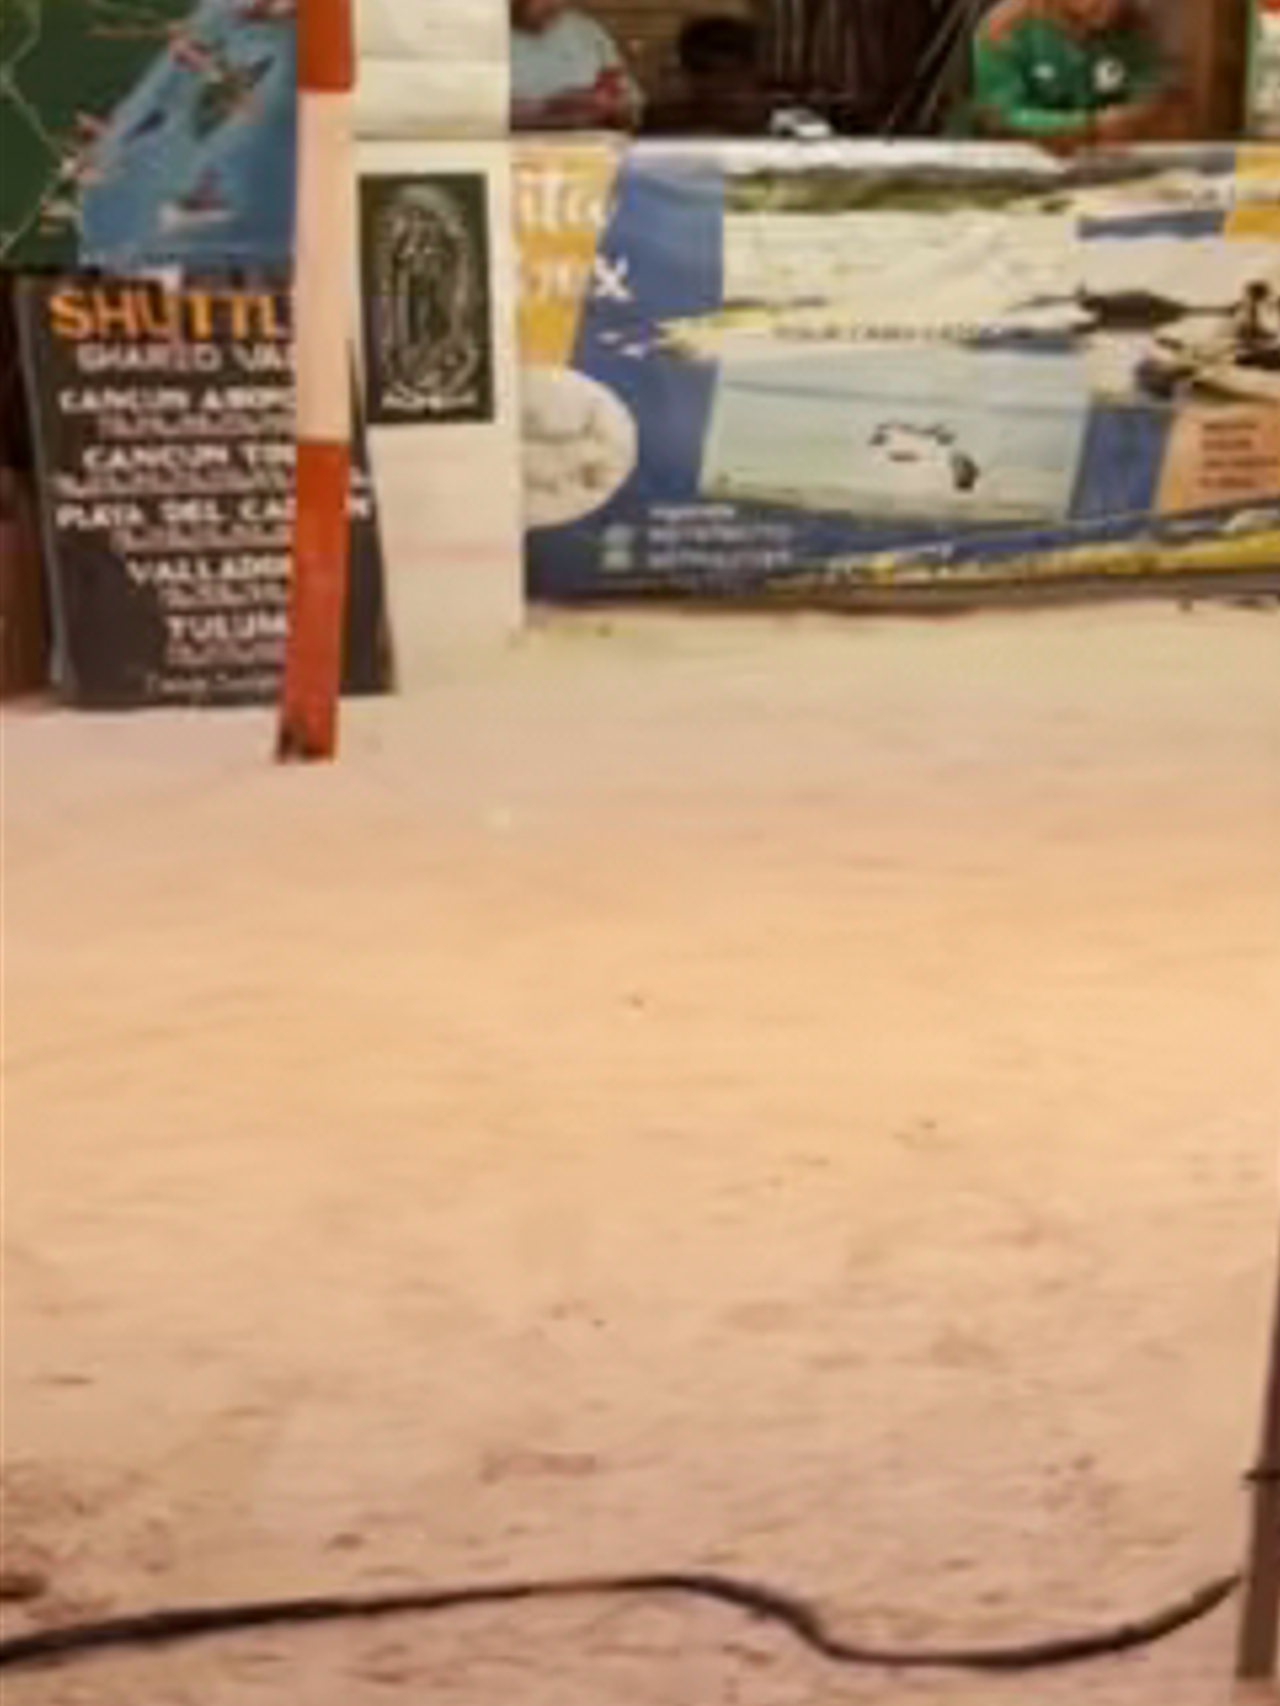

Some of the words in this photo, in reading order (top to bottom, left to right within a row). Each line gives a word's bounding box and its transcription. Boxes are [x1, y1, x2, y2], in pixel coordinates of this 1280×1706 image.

[48, 288, 296, 340] SHUTTL
[82, 444, 229, 470] CANCUN
[56, 500, 146, 529] PLAYA
[161, 498, 224, 523] DEL
[166, 614, 290, 640] TULUM
